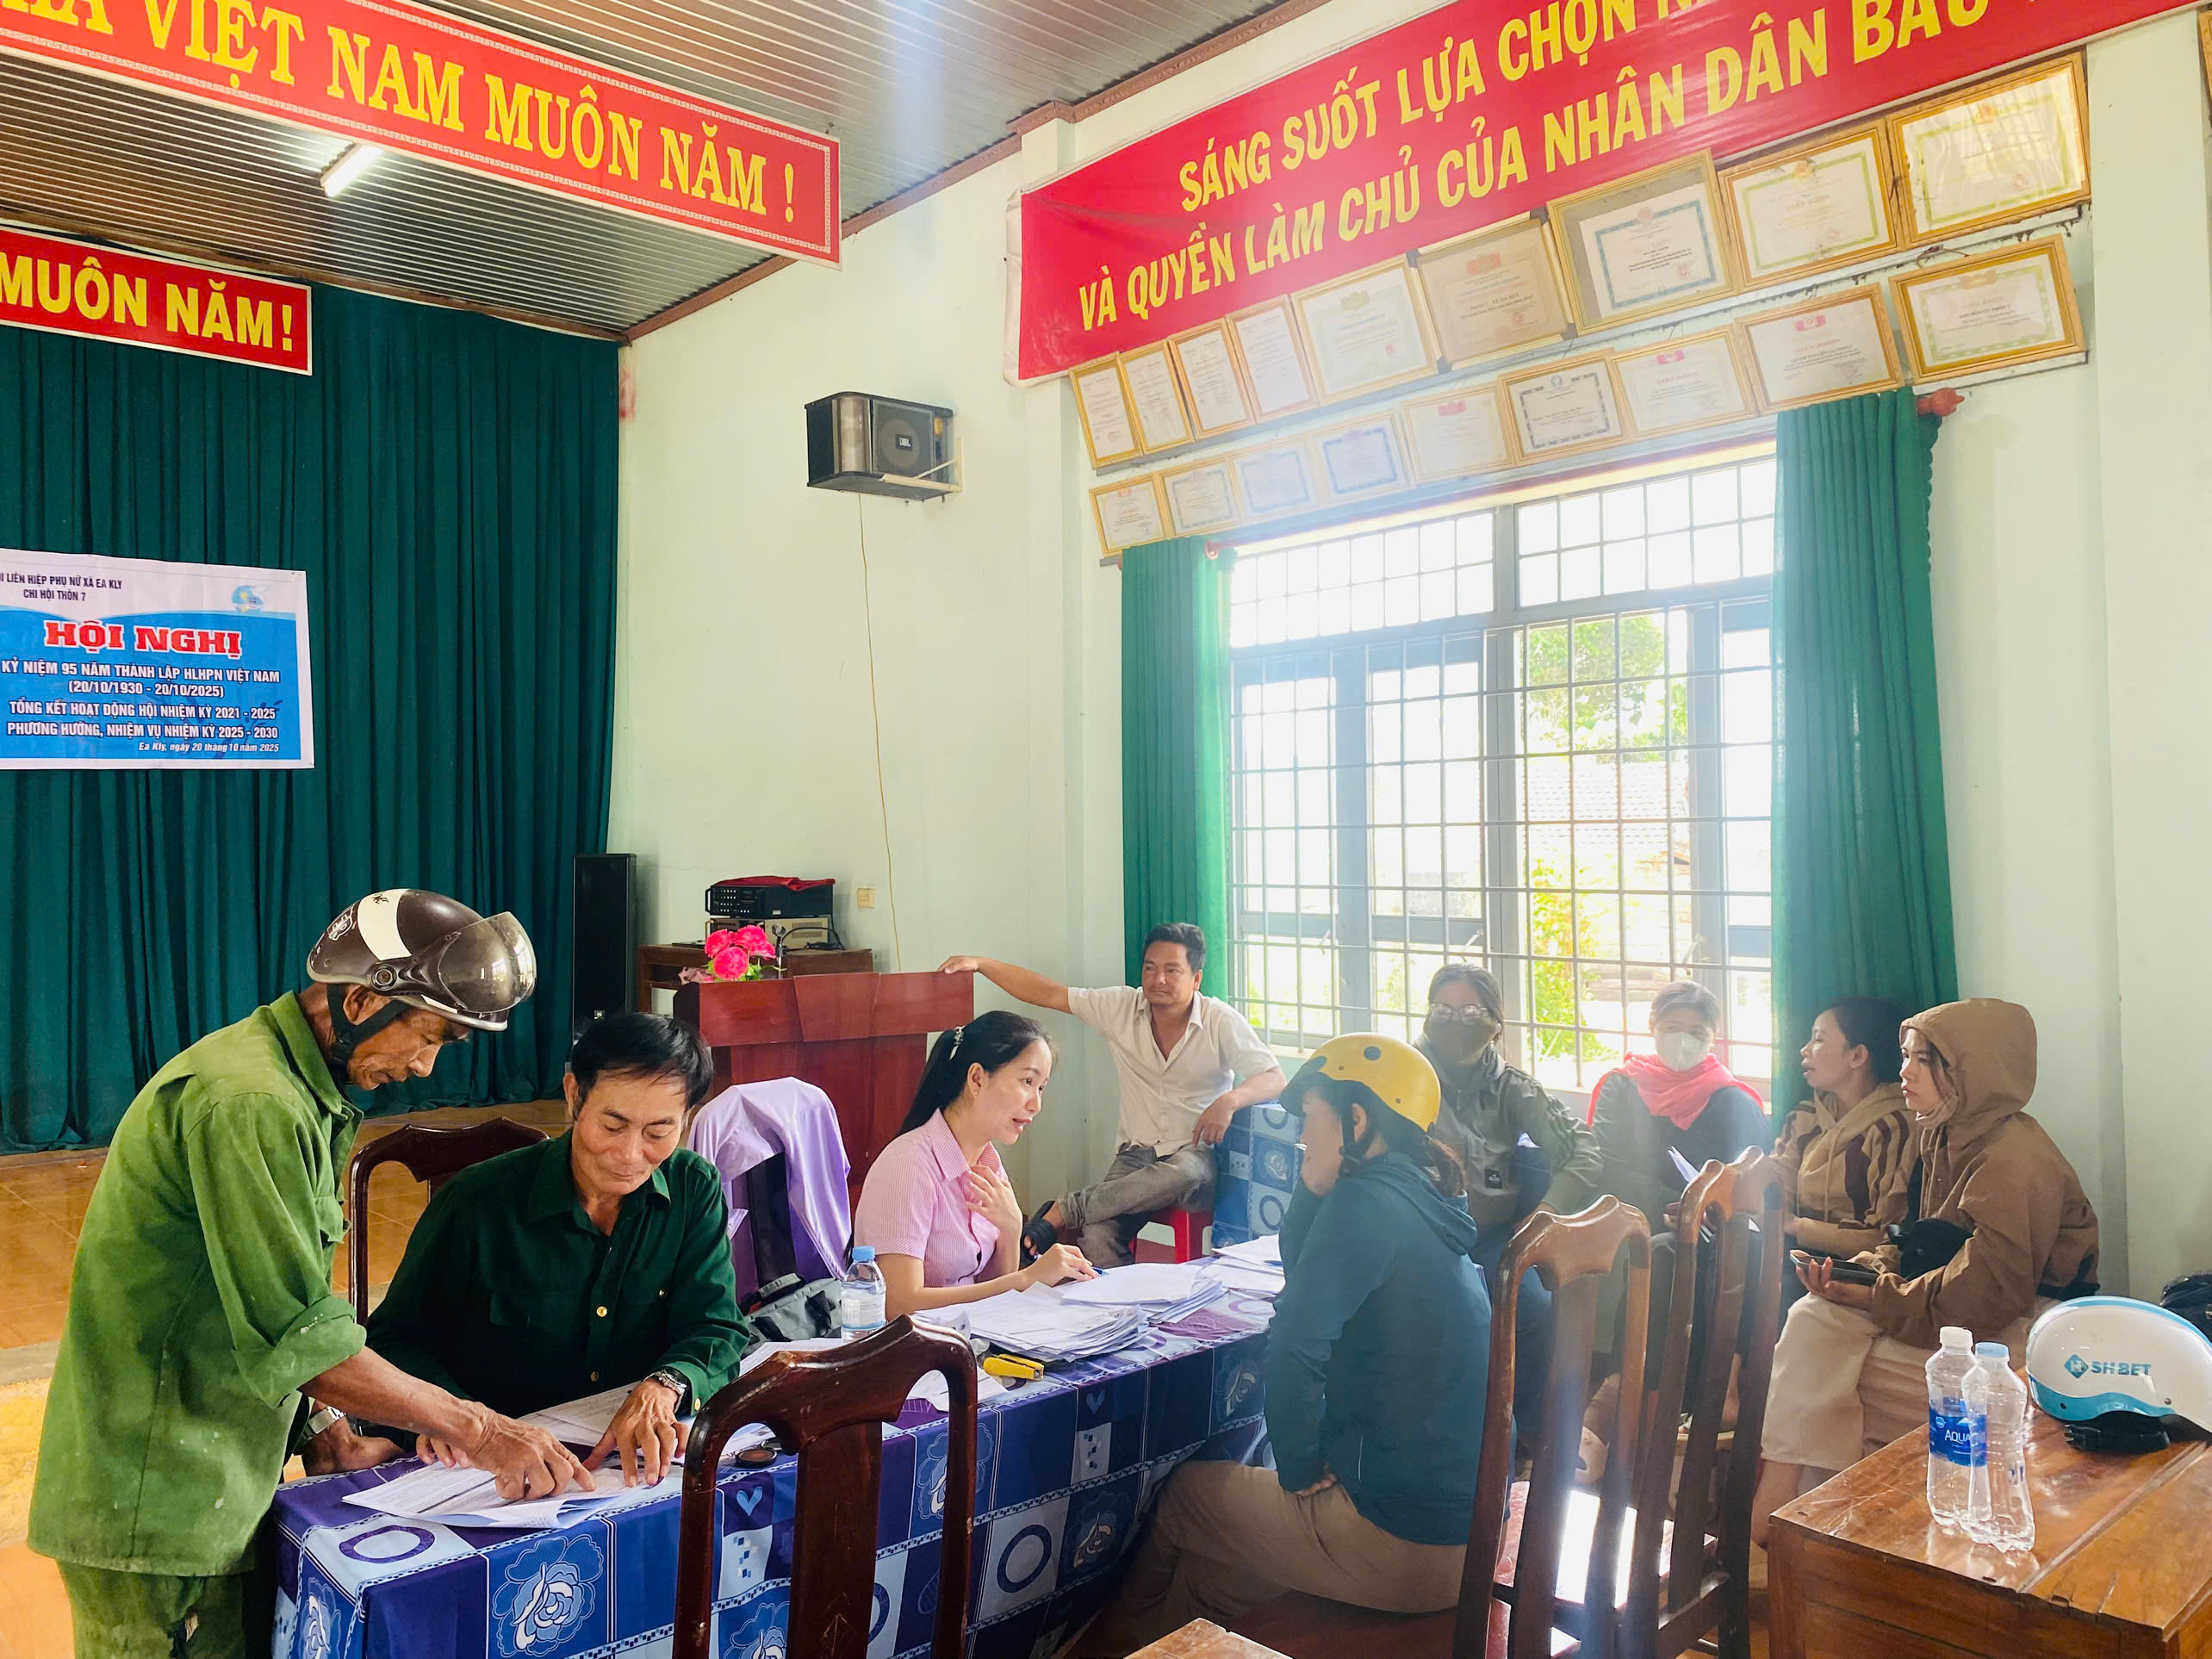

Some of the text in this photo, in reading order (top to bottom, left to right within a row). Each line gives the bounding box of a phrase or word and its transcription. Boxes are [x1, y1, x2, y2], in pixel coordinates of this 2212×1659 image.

[144, 0, 306, 90] VIỆT
[326, 25, 464, 132] NAM
[484, 74, 643, 180] MUÔN
[659, 121, 767, 214] NĂM
[1179, 0, 1637, 212] SÁNG SUỐT LỰA CHỌN
[1079, 264, 1117, 332] VÀ
[1127, 221, 1236, 320] QUYỀN
[1245, 202, 1326, 275] LÀM
[1339, 144, 1420, 242] CHỦ
[1437, 116, 1528, 208] CỦA
[1543, 64, 1685, 173] NHÂN
[1705, 9, 1828, 115] DÂN
[0, 252, 147, 327] MUÔN
[7, 572, 25, 583] LIÊN
[28, 574, 47, 587] HIỆP
[50, 576, 66, 587] PHỤ
[69, 575, 81, 587] NỮ
[83, 576, 94, 587] XÃ
[96, 578, 107, 588] EA
[109, 579, 122, 589] KLY
[23, 588, 86, 601] CHI HỘI THÔN 7
[45, 620, 242, 659] HỘI NGHỊ
[2, 656, 280, 684] KỶ NIỆM 95 NĂM THÀNH LẬP HLHPN VIỆT NAM
[69, 680, 143, 694] (20/10/1930
[154, 683, 224, 698] 20/10/2025)
[9, 697, 42, 714] TỔNG
[46, 699, 67, 715] KẾT
[70, 703, 99, 718] HOẠT
[103, 701, 135, 718] ĐỘNG
[139, 703, 158, 719] HỘI
[160, 702, 196, 719] NHIỆM
[198, 705, 212, 718] KỲ
[215, 707, 239, 718] 2021
[251, 708, 276, 719] 2025
[7, 722, 58, 735] PHƯƠNG
[107, 723, 144, 740] NHIỆM
[147, 725, 161, 738] VỤ
[164, 724, 199, 739] NHIỆM
[202, 724, 215, 737] KỲ
[219, 726, 244, 738] 2025
[254, 727, 278, 738] 2030
[170, 743, 190, 752] ngày
[204, 743, 227, 752] tháng
[260, 743, 279, 752] 2025
[2091, 1360, 2152, 1376] SHBET
